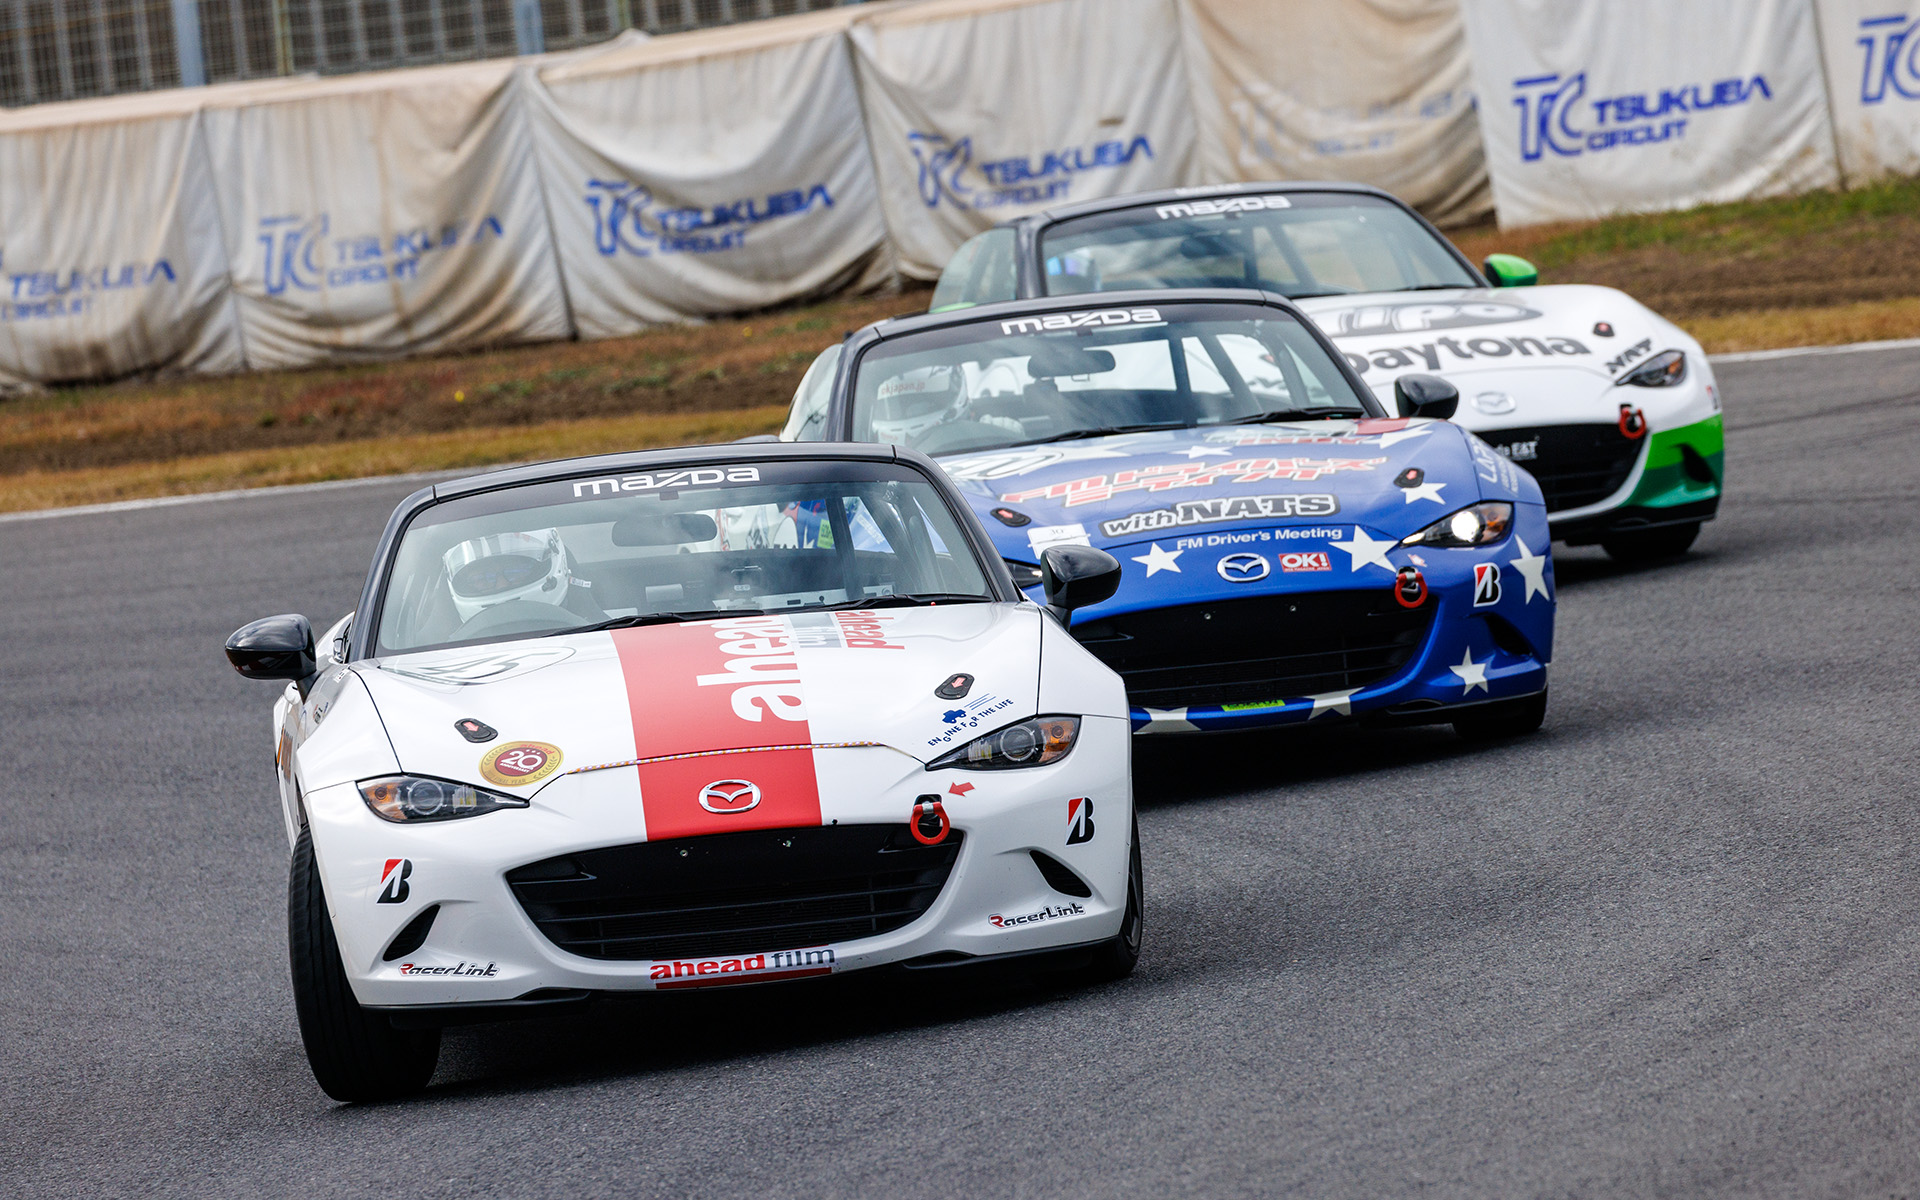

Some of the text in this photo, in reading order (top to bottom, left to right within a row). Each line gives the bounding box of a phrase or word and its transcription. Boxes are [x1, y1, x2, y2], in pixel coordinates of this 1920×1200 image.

[1592, 76, 1772, 124] TSUKUBA
[1587, 119, 1688, 150] CIRCUIT
[980, 136, 1153, 184] TSUKUBA
[656, 184, 834, 233] TSUKUBA
[1155, 196, 1292, 220] mazda
[1001, 308, 1161, 335] mazda
[572, 467, 760, 497] mazda
[1104, 495, 1337, 537] with NATS
[1177, 528, 1342, 550] FM Driver's Meeting
[1282, 553, 1328, 568] OK!
[978, 707, 996, 718] THE
[995, 698, 1014, 710] LIFE
[501, 750, 542, 769] 20
[989, 902, 1085, 928] RacerLink
[399, 962, 498, 977] RacerLink
[650, 949, 835, 980] ahead film
